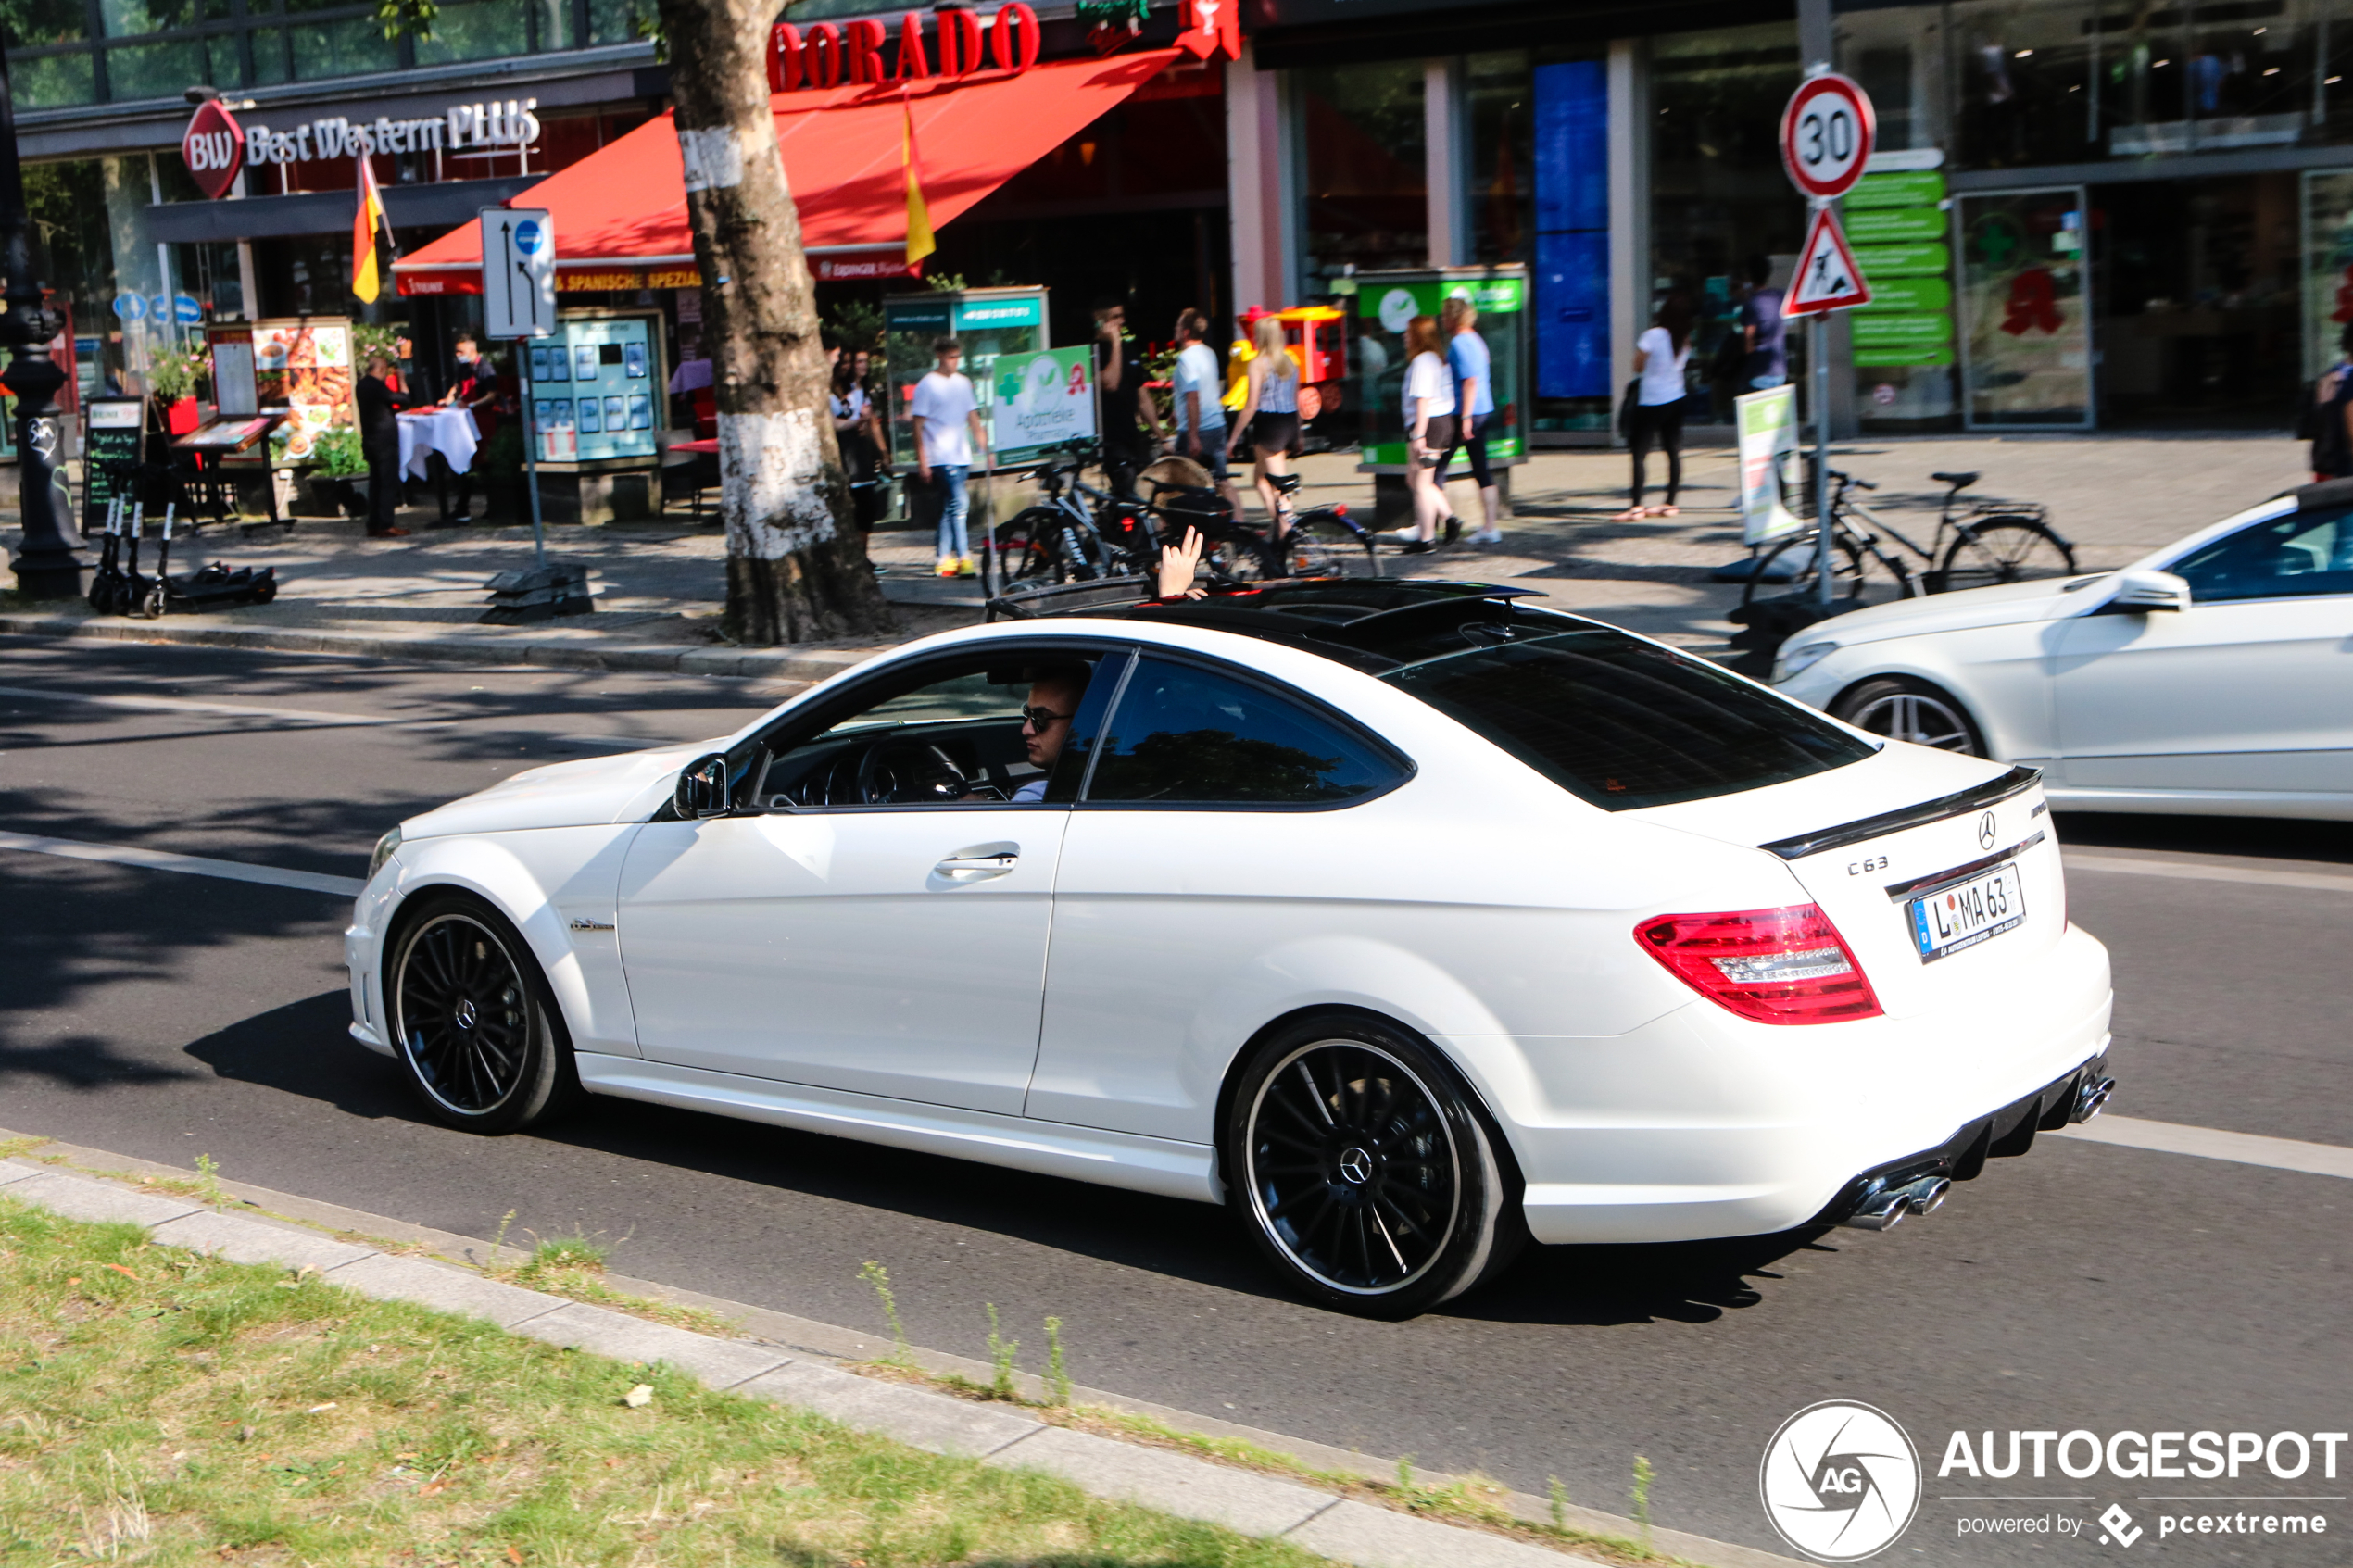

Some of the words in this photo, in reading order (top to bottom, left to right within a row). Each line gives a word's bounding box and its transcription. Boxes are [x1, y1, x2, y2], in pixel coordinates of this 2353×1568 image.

[189, 130, 233, 171] BW
[245, 124, 312, 166] Best
[313, 116, 444, 159] Western
[447, 97, 541, 149] PLUS
[1802, 109, 1853, 166] 30
[567, 272, 643, 292] SPANISCHE
[1847, 862, 1860, 876] C
[1863, 855, 1889, 872] 63
[1933, 901, 1951, 939] L
[1958, 886, 1986, 930] MA
[1986, 877, 2007, 918] 63
[1920, 931, 1928, 945] D
